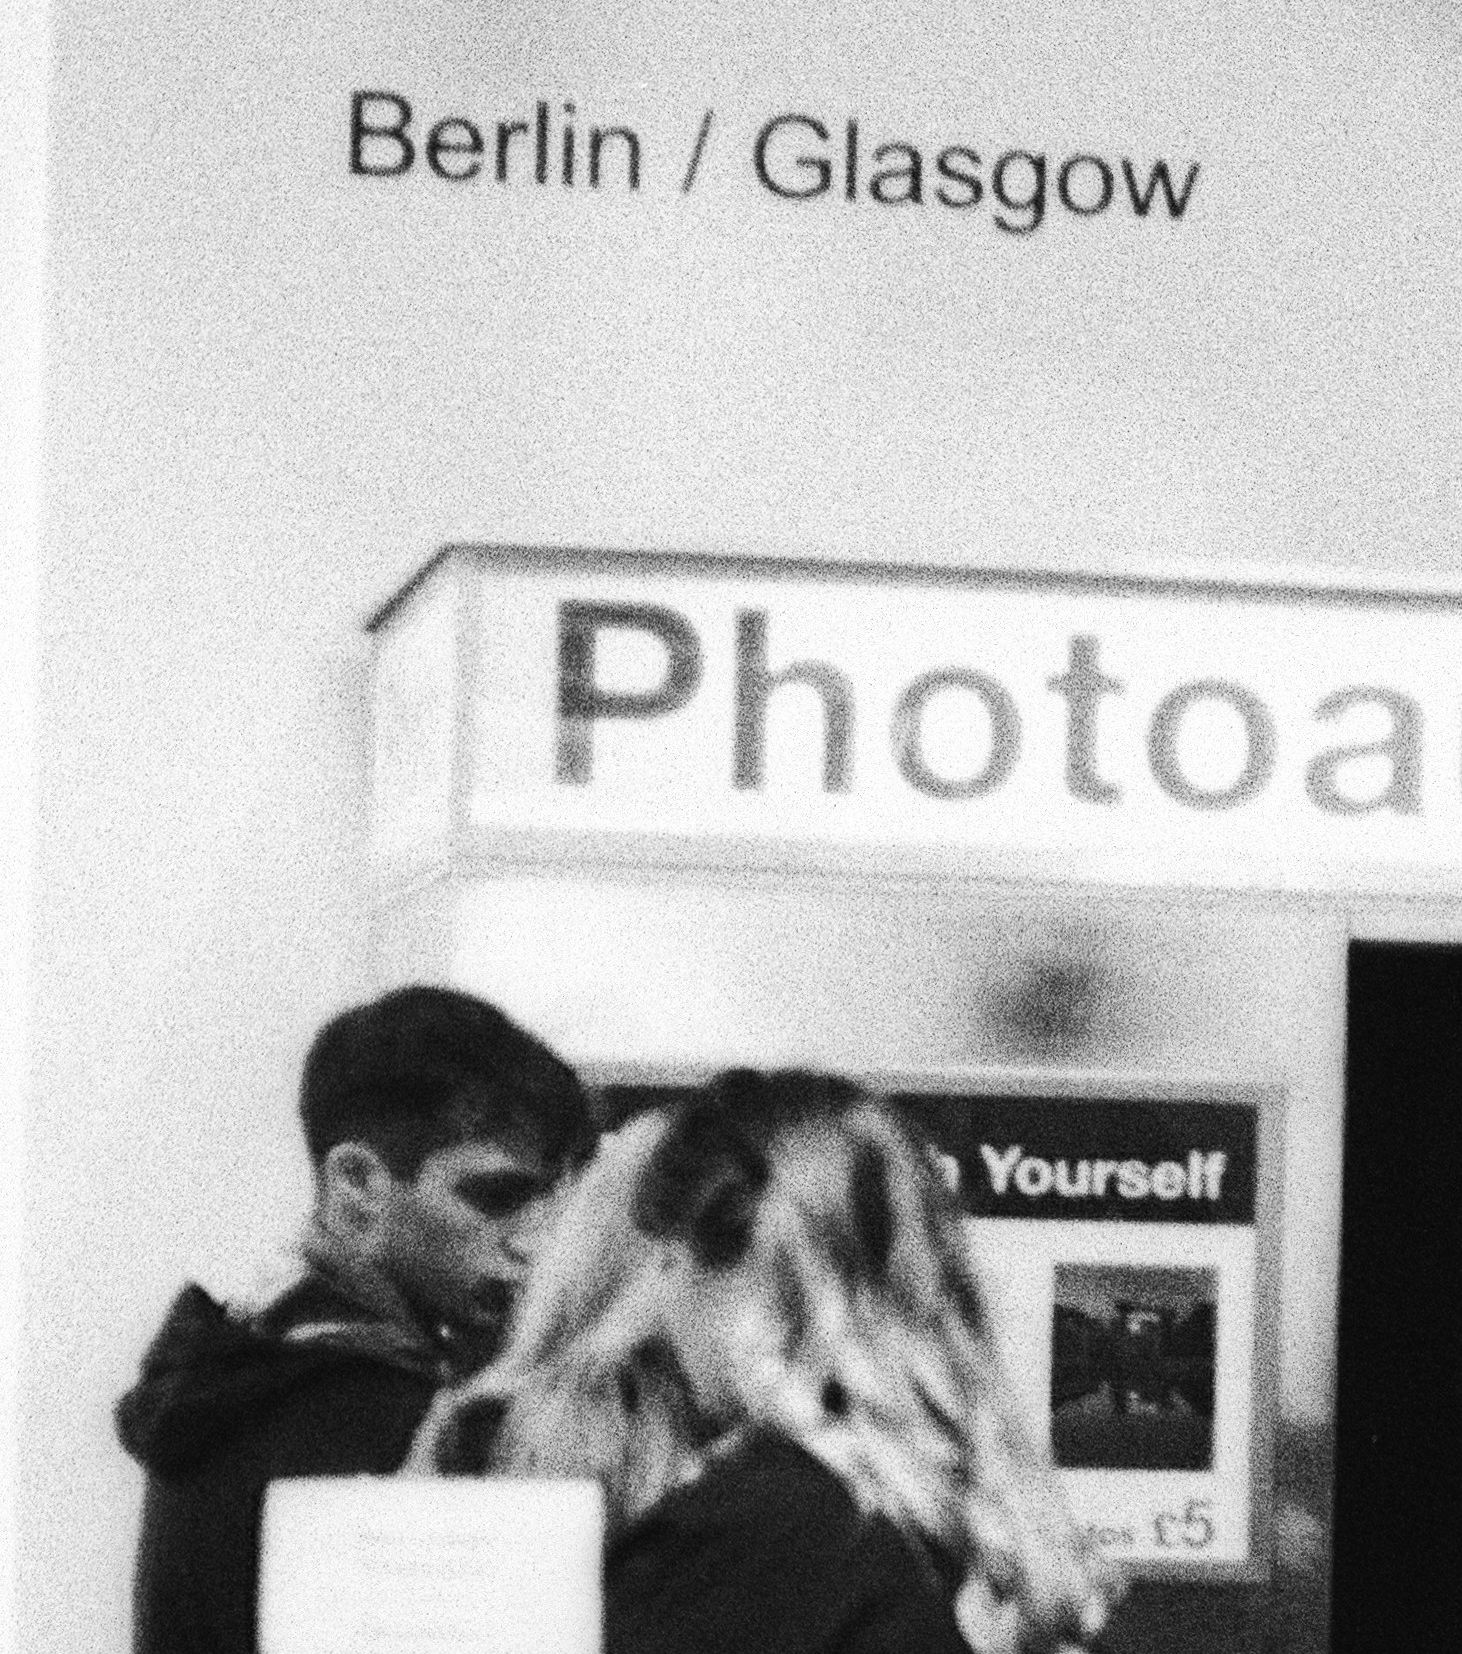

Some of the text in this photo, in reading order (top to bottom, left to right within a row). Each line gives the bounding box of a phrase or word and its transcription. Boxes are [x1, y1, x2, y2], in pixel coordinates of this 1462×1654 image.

[348, 89, 1201, 236] Berlin / Glasgow
[979, 1143, 1228, 1202] Yourself
